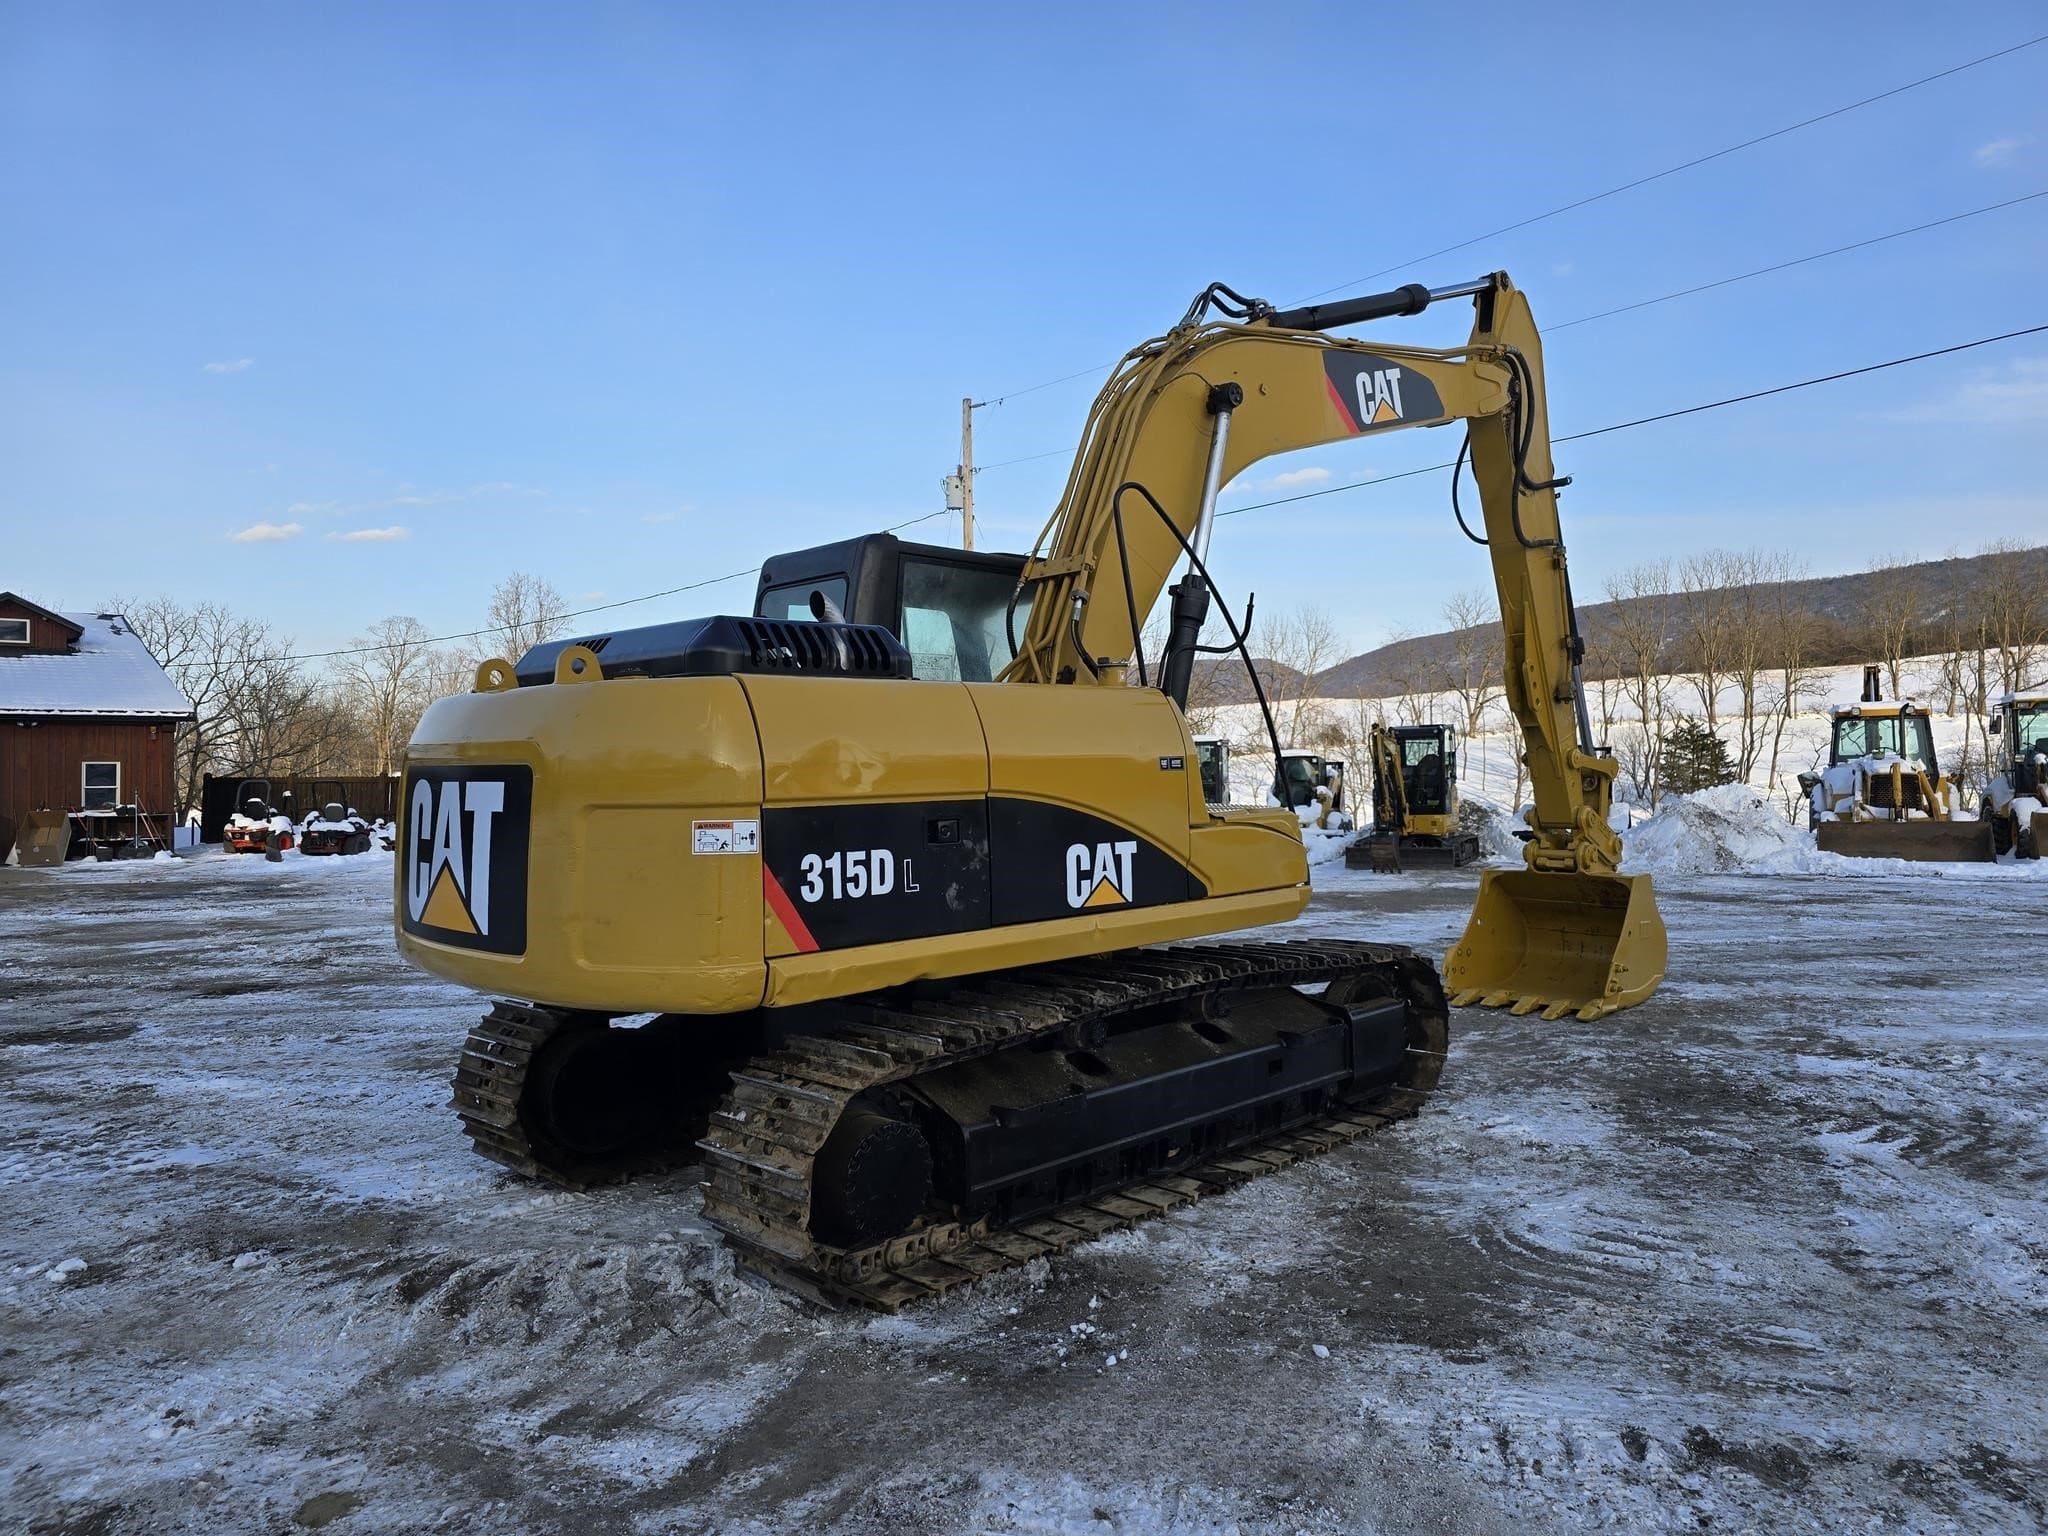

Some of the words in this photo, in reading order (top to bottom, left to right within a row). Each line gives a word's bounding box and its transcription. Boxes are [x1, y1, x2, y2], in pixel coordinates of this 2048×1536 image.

[1355, 367, 1403, 425] CAT
[408, 778, 505, 936] CAT
[800, 849, 894, 903] 315D
[903, 858, 920, 893] L
[1066, 841, 1137, 909] CAT
